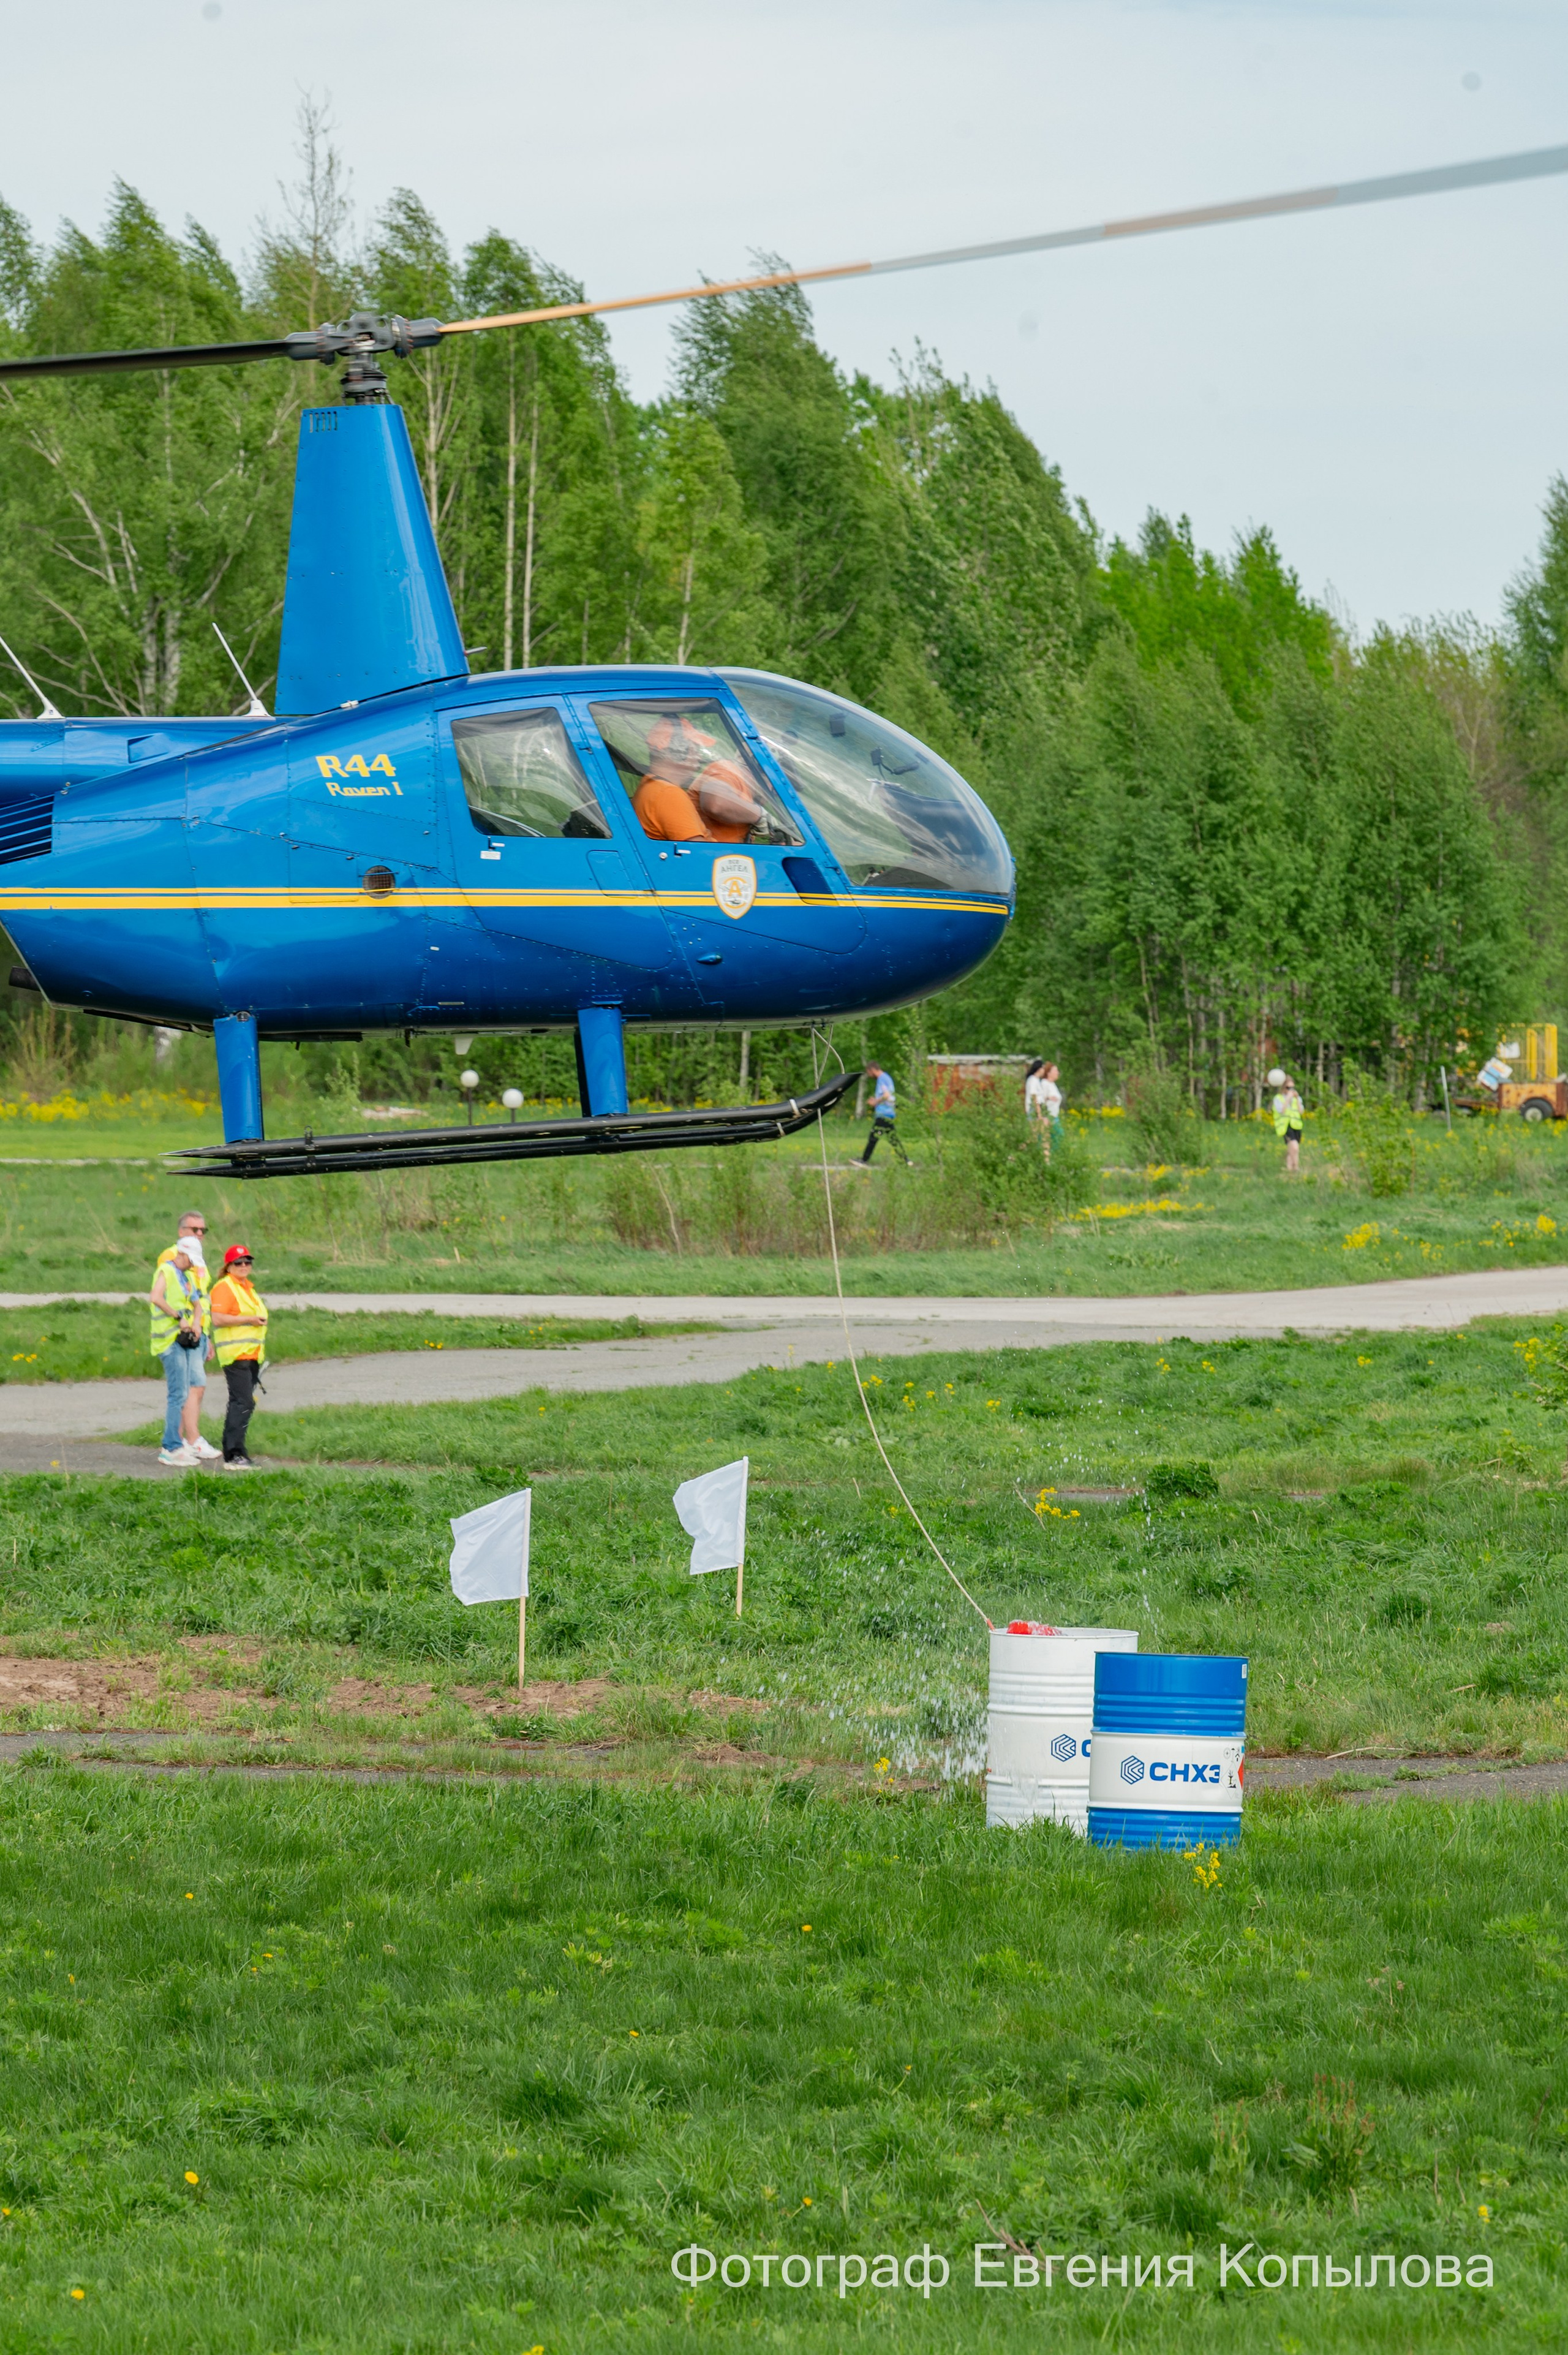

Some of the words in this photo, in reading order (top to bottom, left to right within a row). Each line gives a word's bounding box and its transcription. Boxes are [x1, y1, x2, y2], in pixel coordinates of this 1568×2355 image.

[315, 754, 396, 777] R44
[325, 782, 391, 796] Raven
[721, 864, 748, 873] АНГЕЛ
